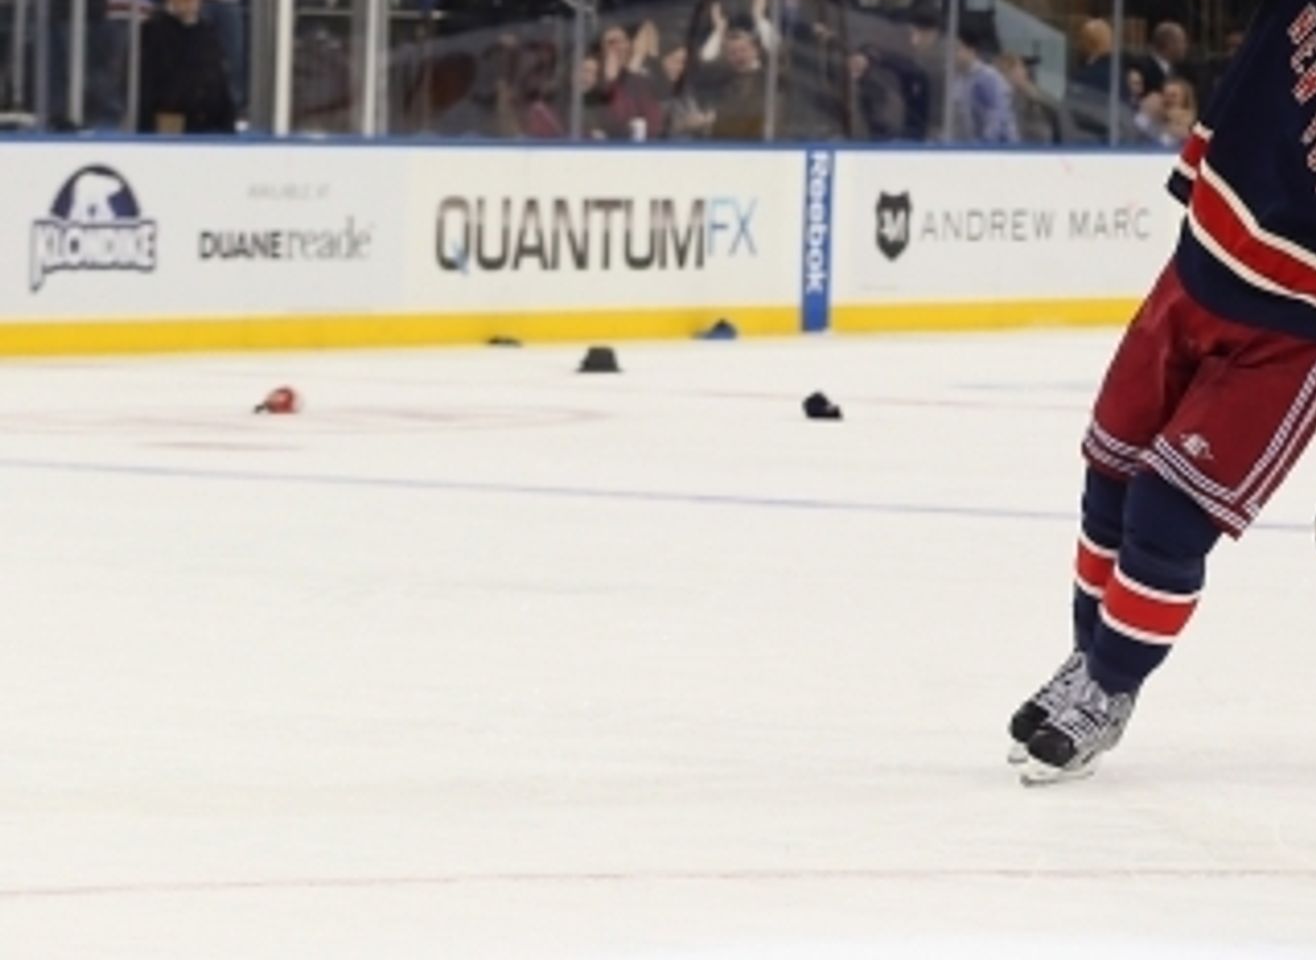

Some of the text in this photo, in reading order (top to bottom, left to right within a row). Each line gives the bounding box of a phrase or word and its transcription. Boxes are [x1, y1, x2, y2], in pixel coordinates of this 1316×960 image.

[804, 151, 830, 295] Reebok
[921, 208, 1153, 242] ANDREW MARC
